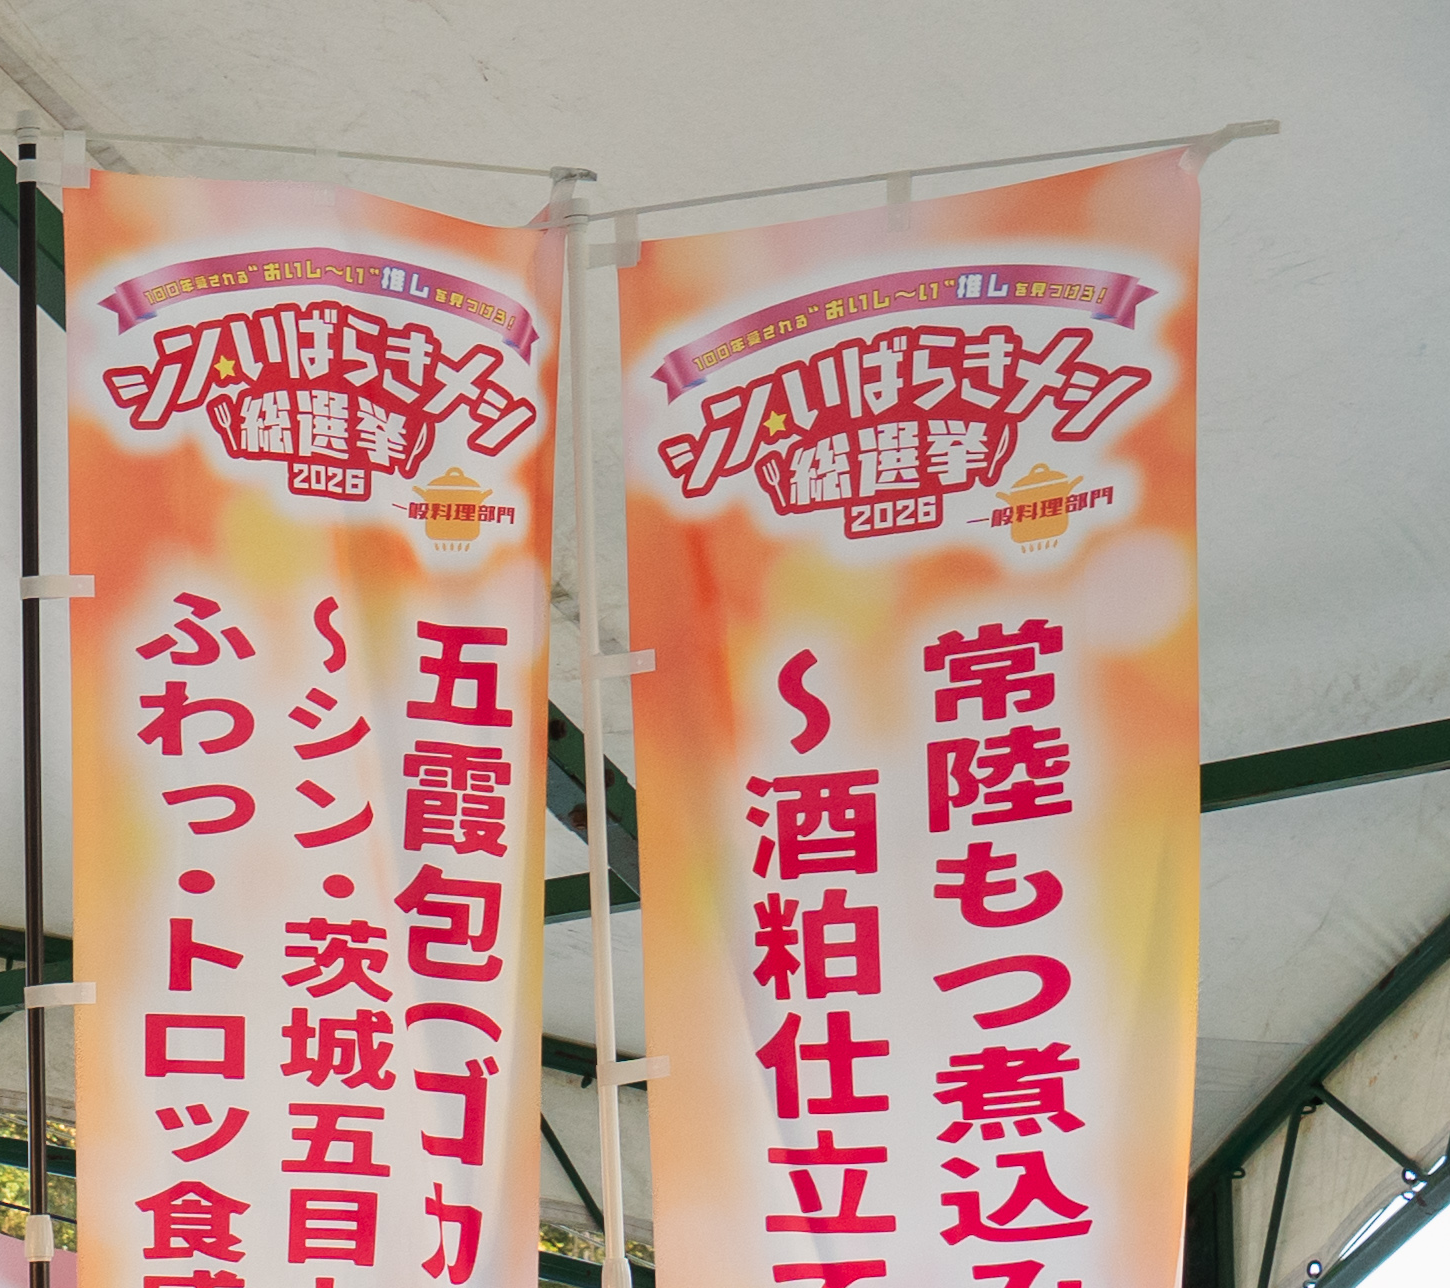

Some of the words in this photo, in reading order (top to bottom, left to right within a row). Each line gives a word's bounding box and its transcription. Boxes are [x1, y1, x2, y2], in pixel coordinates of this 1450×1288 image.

[112, 306, 533, 449] シンいばらきメシ
[666, 335, 1144, 489] シンいばらきメシ
[240, 389, 408, 467] 総選挙
[790, 420, 989, 506] 総選挙
[292, 464, 366, 495] 2026
[852, 497, 937, 532] 2026
